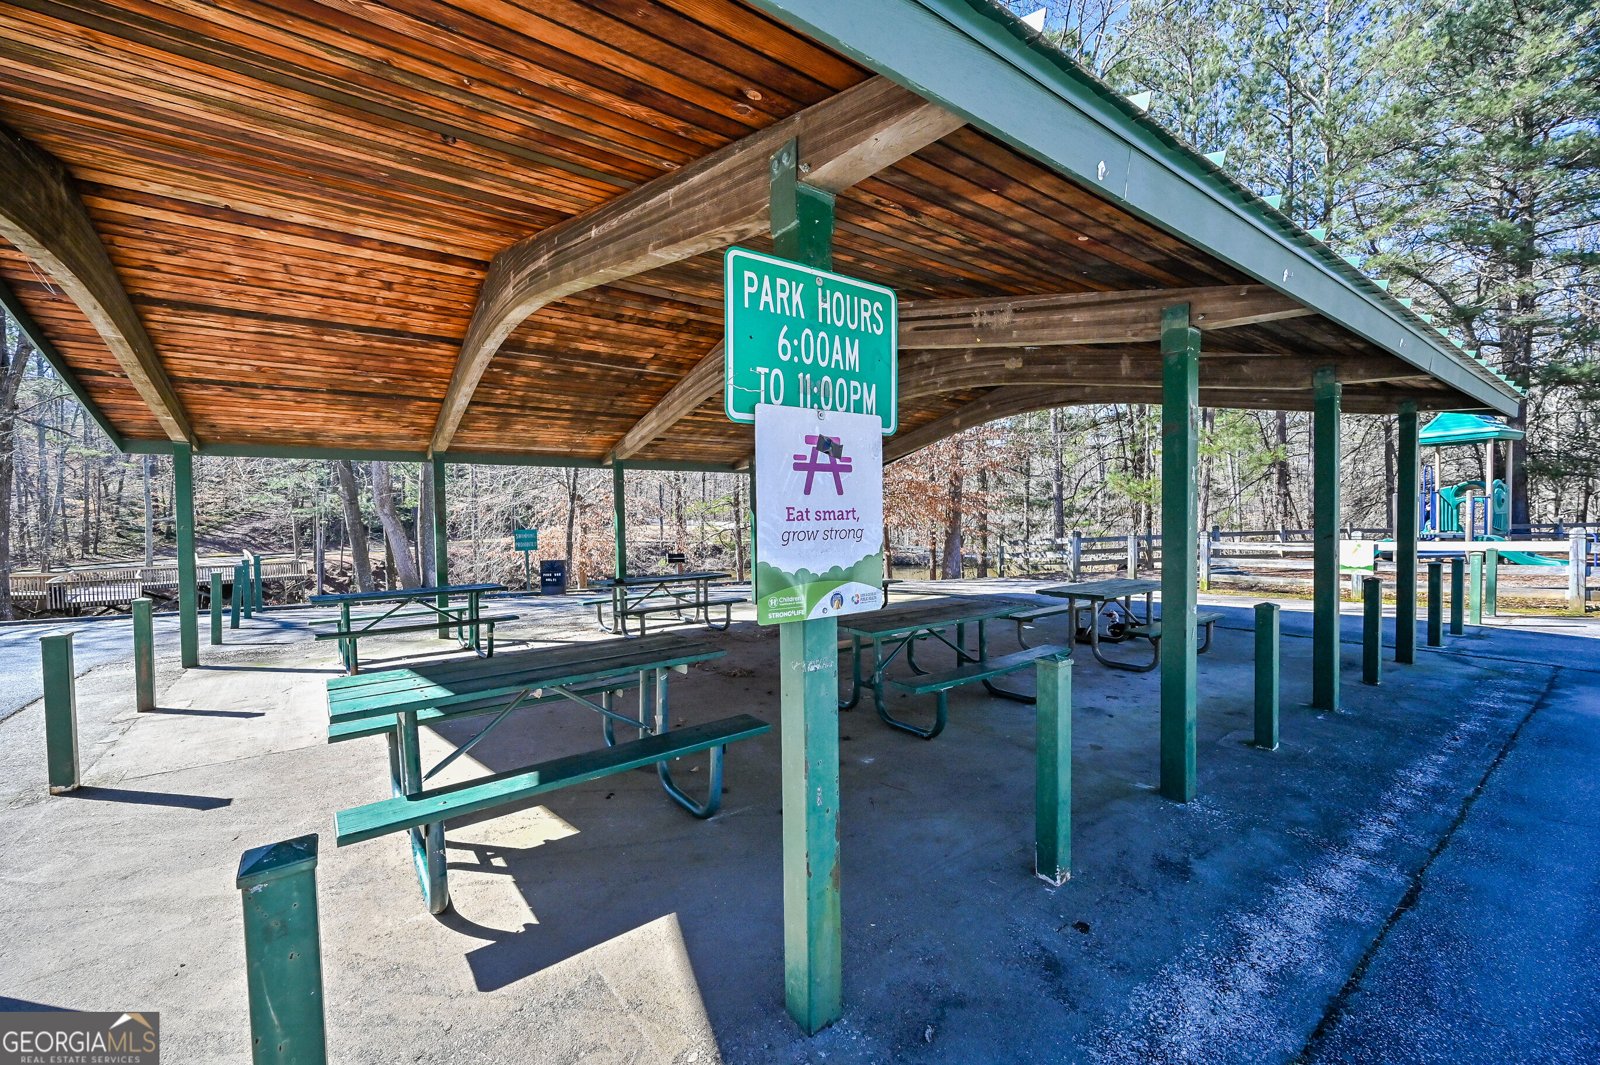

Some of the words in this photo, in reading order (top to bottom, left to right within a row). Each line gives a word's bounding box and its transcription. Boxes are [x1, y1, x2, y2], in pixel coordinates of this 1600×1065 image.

[743, 270, 805, 320] PARK
[817, 287, 884, 336] HOURS
[777, 324, 860, 373] 6:00AM
[756, 366, 785, 405] TO
[797, 371, 877, 416] 11:00PM
[781, 530, 819, 546] grow
[822, 527, 864, 542] strong
[785, 506, 810, 522] Eat
[814, 507, 860, 522] smart,
